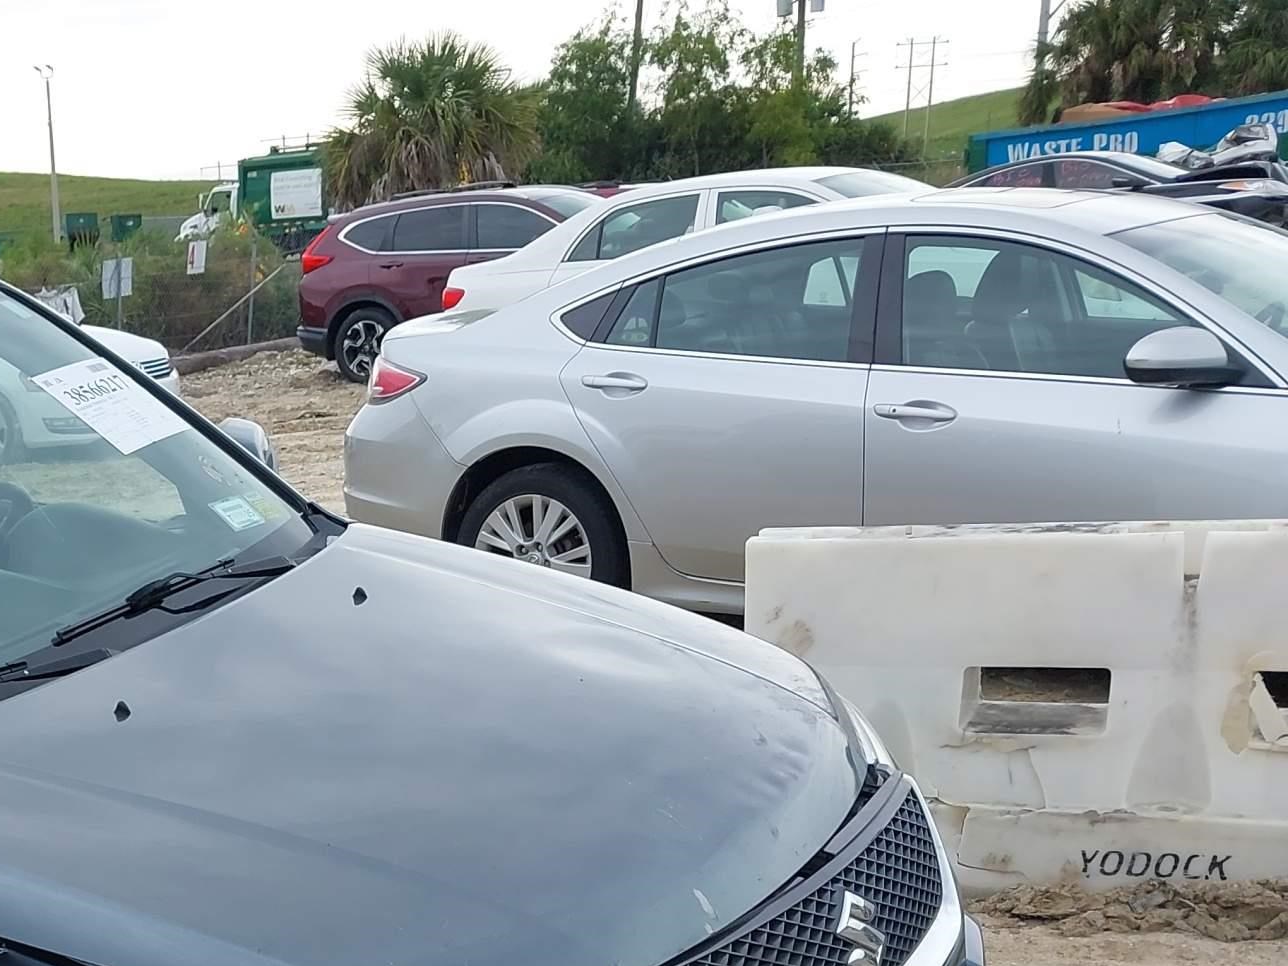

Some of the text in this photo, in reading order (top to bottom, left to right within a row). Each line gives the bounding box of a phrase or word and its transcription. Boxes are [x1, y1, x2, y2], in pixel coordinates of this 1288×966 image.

[1007, 131, 1139, 163] WASTE PRO
[63, 375, 130, 406] 38566217
[1080, 849, 1232, 881] YODOCK
